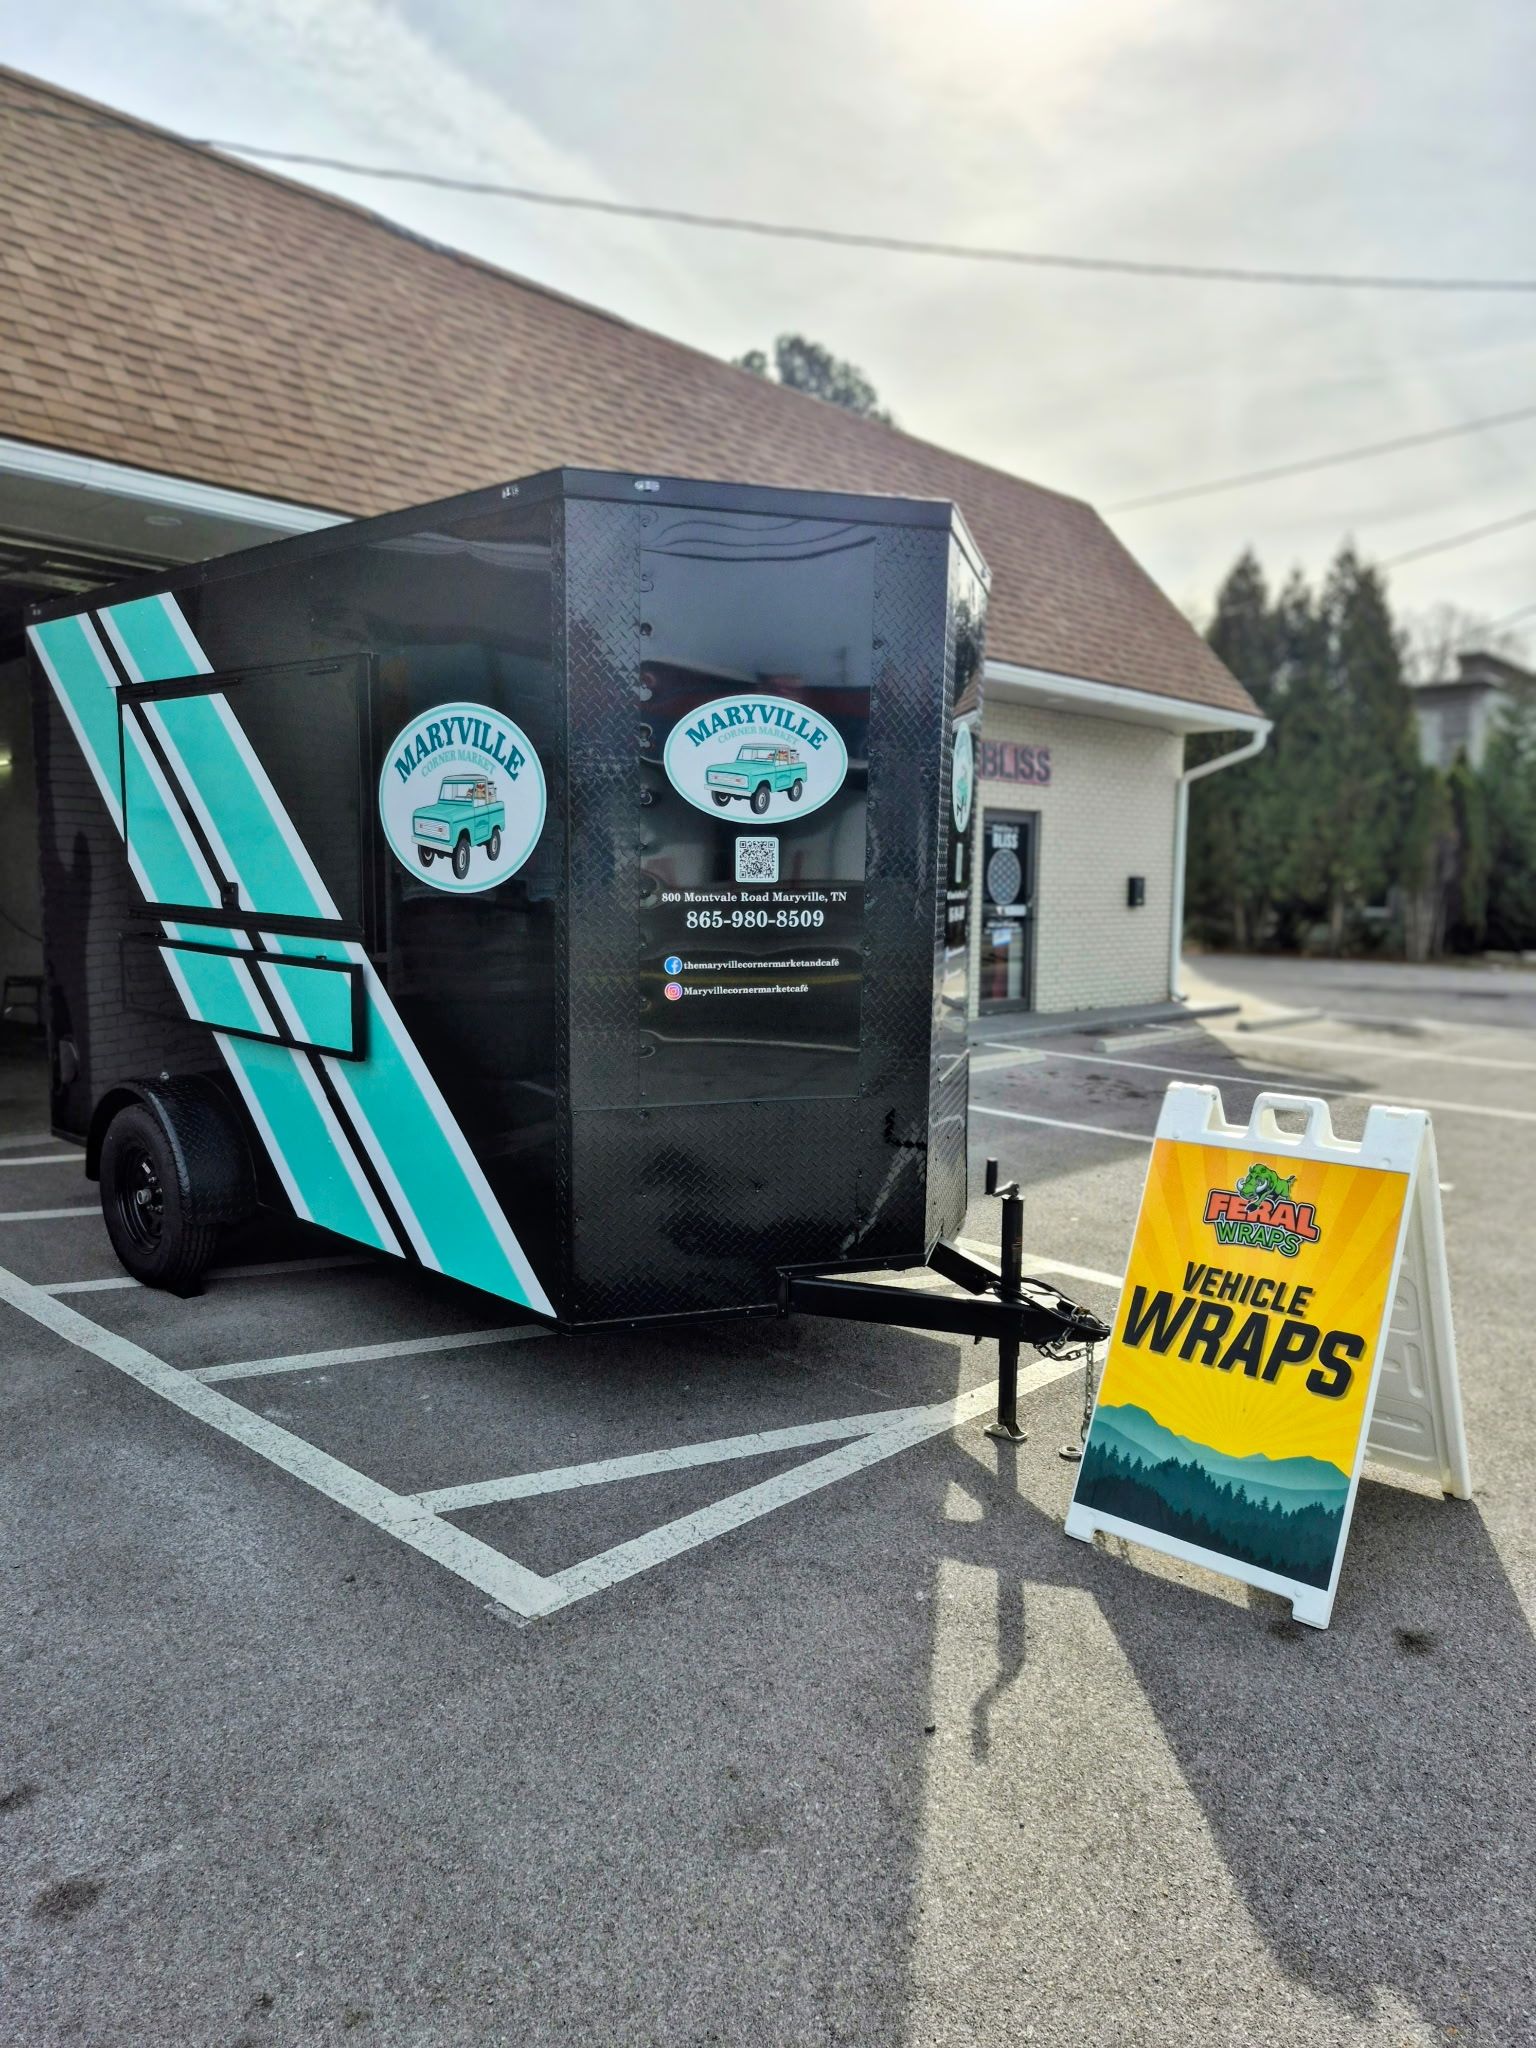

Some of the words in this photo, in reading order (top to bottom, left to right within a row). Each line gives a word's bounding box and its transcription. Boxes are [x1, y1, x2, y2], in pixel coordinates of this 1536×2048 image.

[685, 703, 829, 750] MARYVILLE
[718, 726, 757, 744] CORNER
[758, 726, 799, 745] MARKET
[394, 716, 526, 784] MARYVILLE
[421, 750, 457, 777] CORNER
[457, 750, 498, 775] MARKET
[981, 741, 1052, 783] BLISS
[661, 892, 681, 902] 800
[684, 892, 738, 902] Montvale
[741, 892, 769, 902] Road
[772, 891, 828, 904] Maryville,
[830, 891, 847, 902] TN
[686, 909, 824, 928] 865-980-8509
[683, 958, 840, 971] themaryvillecornermarketandcafé
[683, 984, 809, 997] Maryvillecornermarketcafé
[1204, 1190, 1319, 1241] FERAL
[1215, 1220, 1301, 1256] WRAPS
[1182, 1261, 1315, 1317] VEHICLE
[1122, 1285, 1365, 1398] WRAPS
